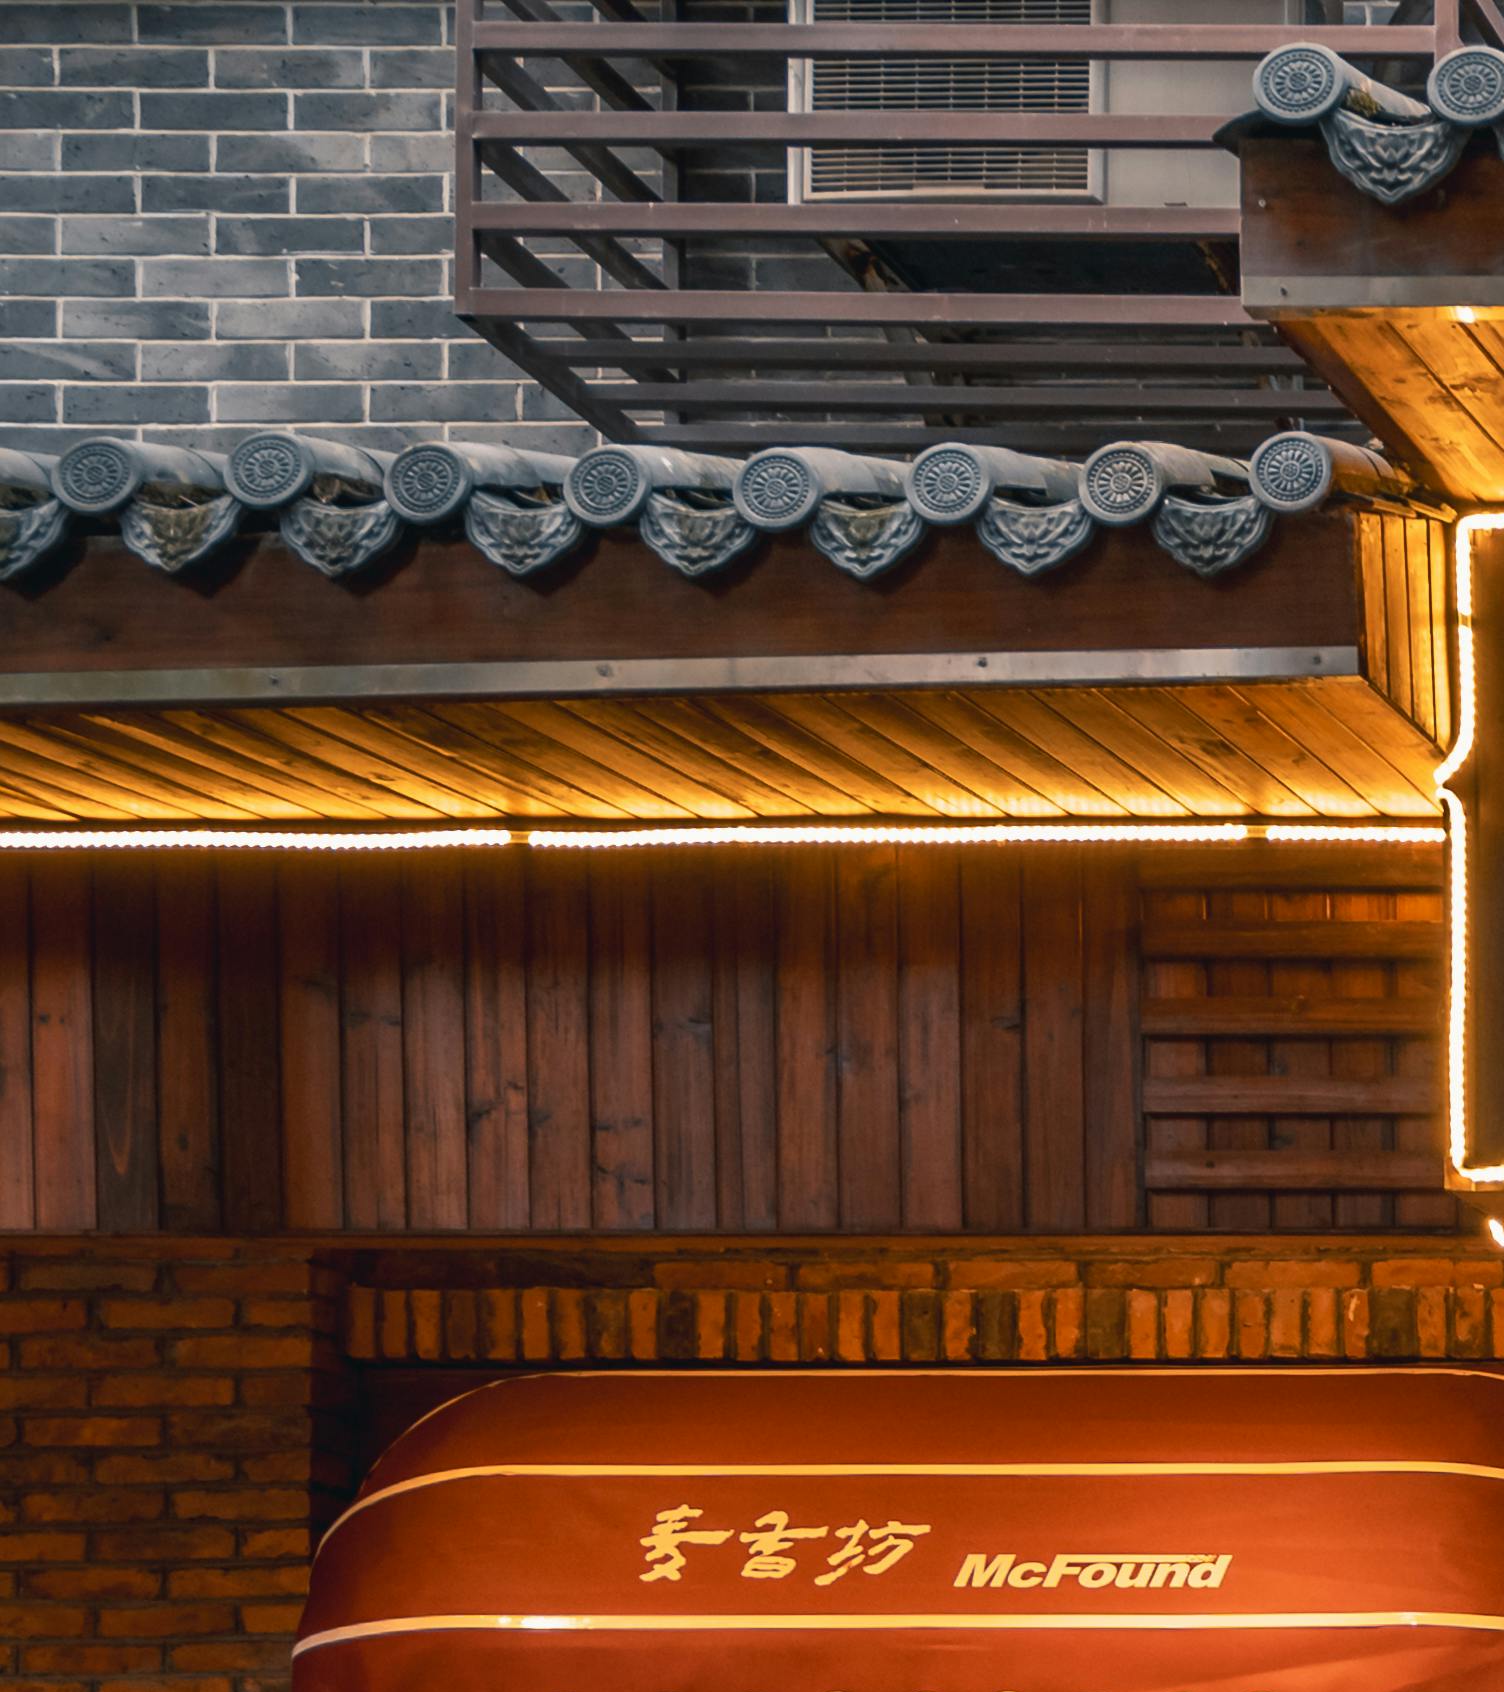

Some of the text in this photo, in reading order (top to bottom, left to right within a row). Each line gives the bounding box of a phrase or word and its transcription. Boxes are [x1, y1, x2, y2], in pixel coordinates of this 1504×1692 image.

[639, 1504, 931, 1587] 麦香坊
[954, 1554, 1233, 1588] McFound
